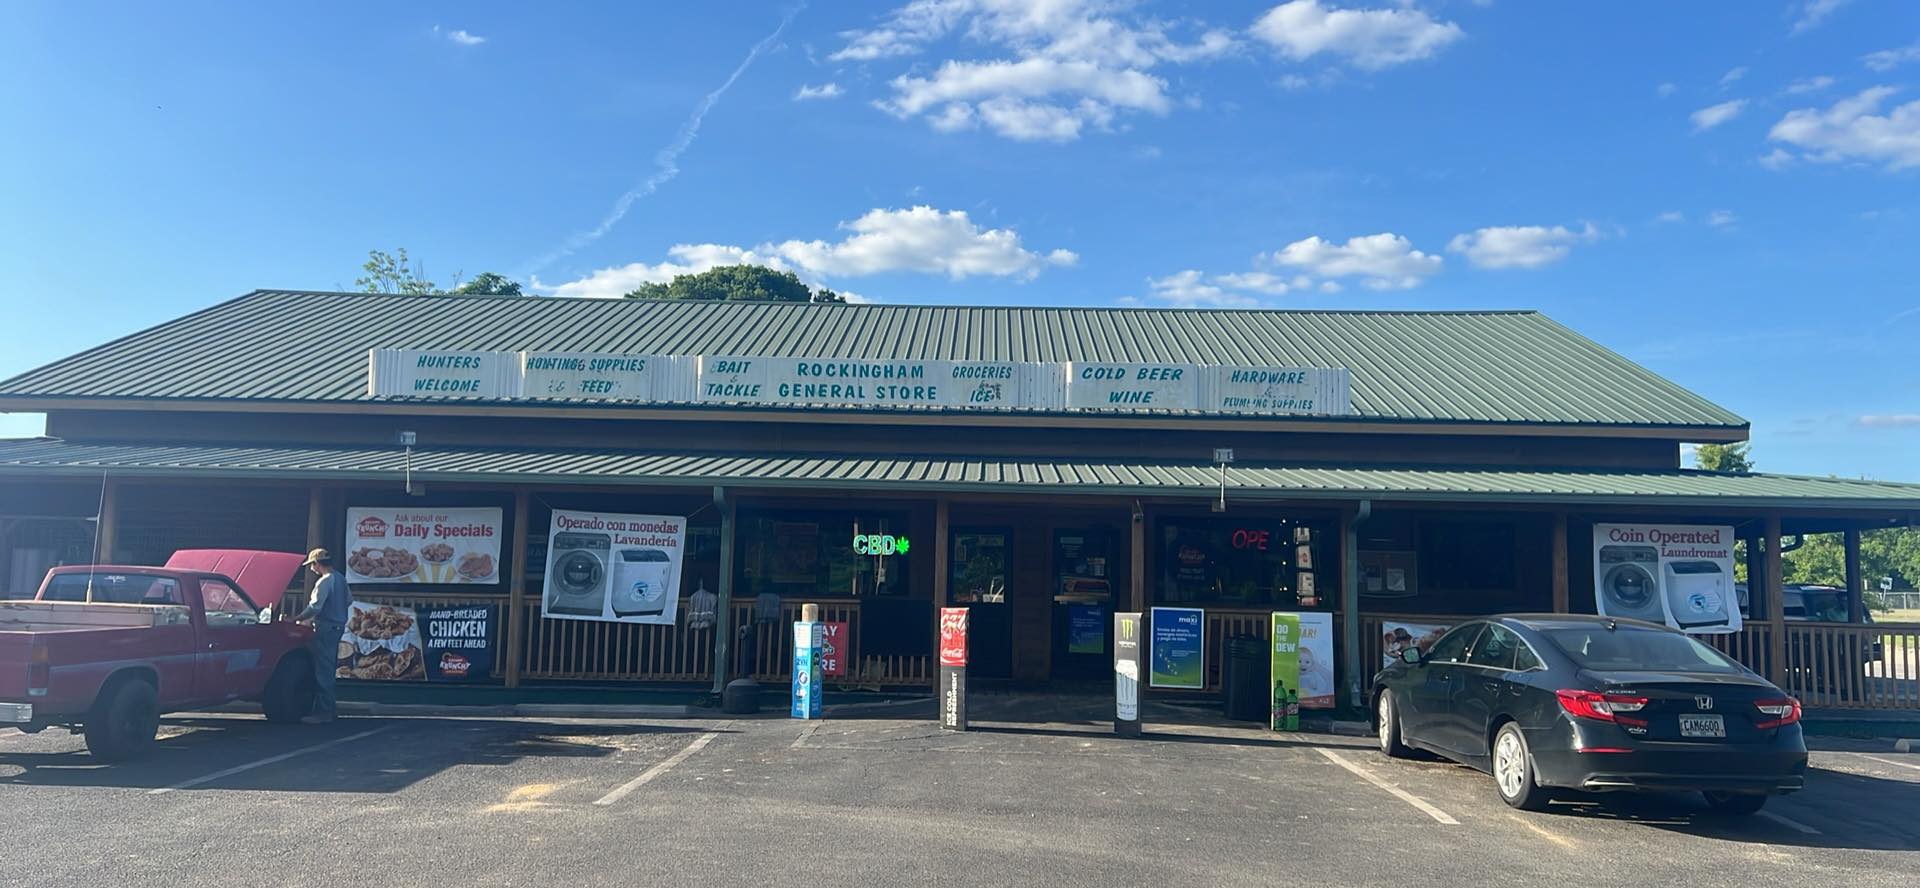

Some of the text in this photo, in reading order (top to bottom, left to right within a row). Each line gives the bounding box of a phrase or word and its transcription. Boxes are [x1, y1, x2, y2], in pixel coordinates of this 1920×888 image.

[417, 355, 481, 369] HUNTERS
[589, 358, 645, 371] SUPPLIES
[717, 360, 752, 373] BAIT
[797, 362, 924, 379] ROCKINGHAM
[952, 366, 1012, 379] GROCERIES
[1082, 367, 1184, 381] COLD BEER
[1231, 370, 1305, 384] HARDWARE
[414, 378, 481, 392] WELCOME
[582, 379, 612, 393] FEED
[707, 383, 761, 396] TACKLE
[778, 383, 937, 400] GENERAL STORE
[970, 389, 992, 402] ICE
[1109, 391, 1154, 404] WINE
[395, 514, 408, 522] Ask
[411, 513, 433, 522] about
[557, 515, 679, 534] Operado con monedas
[395, 524, 493, 540] Daily Specials
[1609, 528, 1720, 546] Coin Operated
[614, 534, 677, 547] Lavandería
[853, 535, 896, 555] CBD
[1661, 547, 1728, 558] Laundromat
[429, 609, 487, 619] HAND-BREADED
[429, 620, 486, 637] CHICKEN
[822, 625, 838, 636] AY
[1276, 624, 1289, 634] DO
[1299, 628, 1318, 639] AR!
[428, 639, 486, 649] A FEW FEET AHEAD
[1276, 642, 1296, 653] DEW
[1683, 720, 1719, 731] CAM6600
